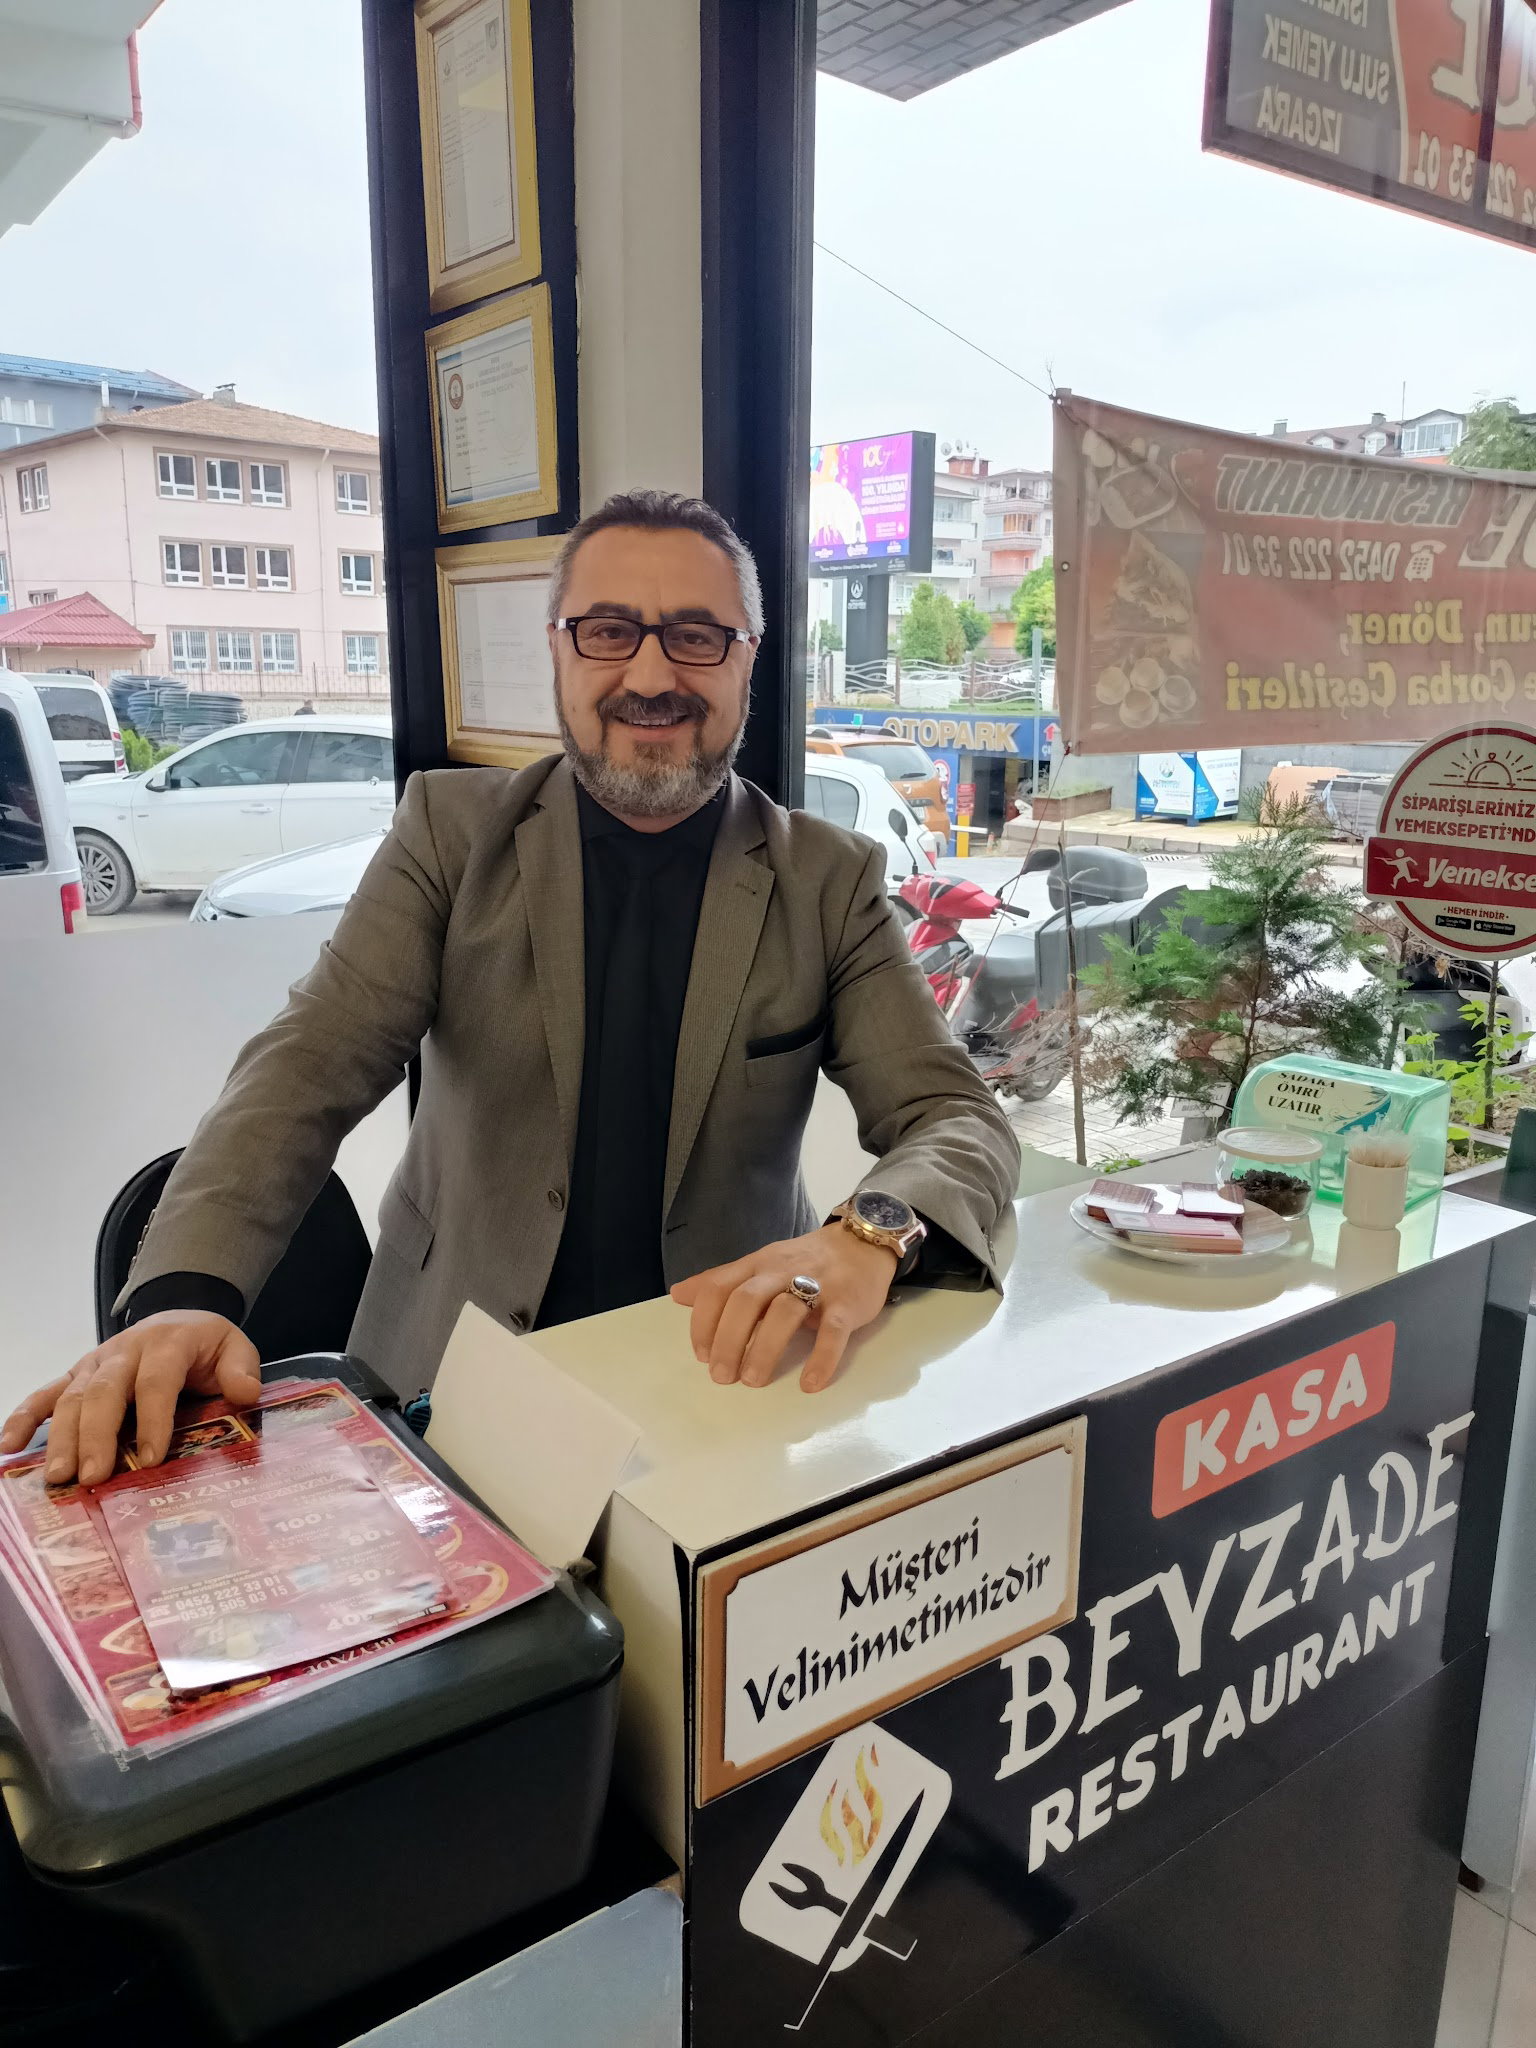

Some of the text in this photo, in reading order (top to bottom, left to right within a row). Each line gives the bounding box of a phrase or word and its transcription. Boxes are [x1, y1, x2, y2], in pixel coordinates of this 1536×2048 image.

[883, 715, 1021, 753] OTOPARK
[1447, 906, 1505, 920] HEMEN İNDİR
[1277, 1081, 1325, 1099] ÖMRÜ
[1279, 1072, 1336, 1089] SADAKA
[1268, 1095, 1322, 1116] UZATIR
[1182, 1352, 1369, 1492] KASA
[148, 1475, 258, 1508] BEYZADE
[838, 1516, 981, 1621] Müşteri
[175, 1574, 282, 1611] 0452 222 33 01
[180, 1583, 289, 1622] 0532 505 03 15
[994, 1410, 1476, 1782] BEYZADE
[742, 1551, 1052, 1725] Velinimetimizdir
[1028, 1561, 1437, 1875] RESTAURANT
